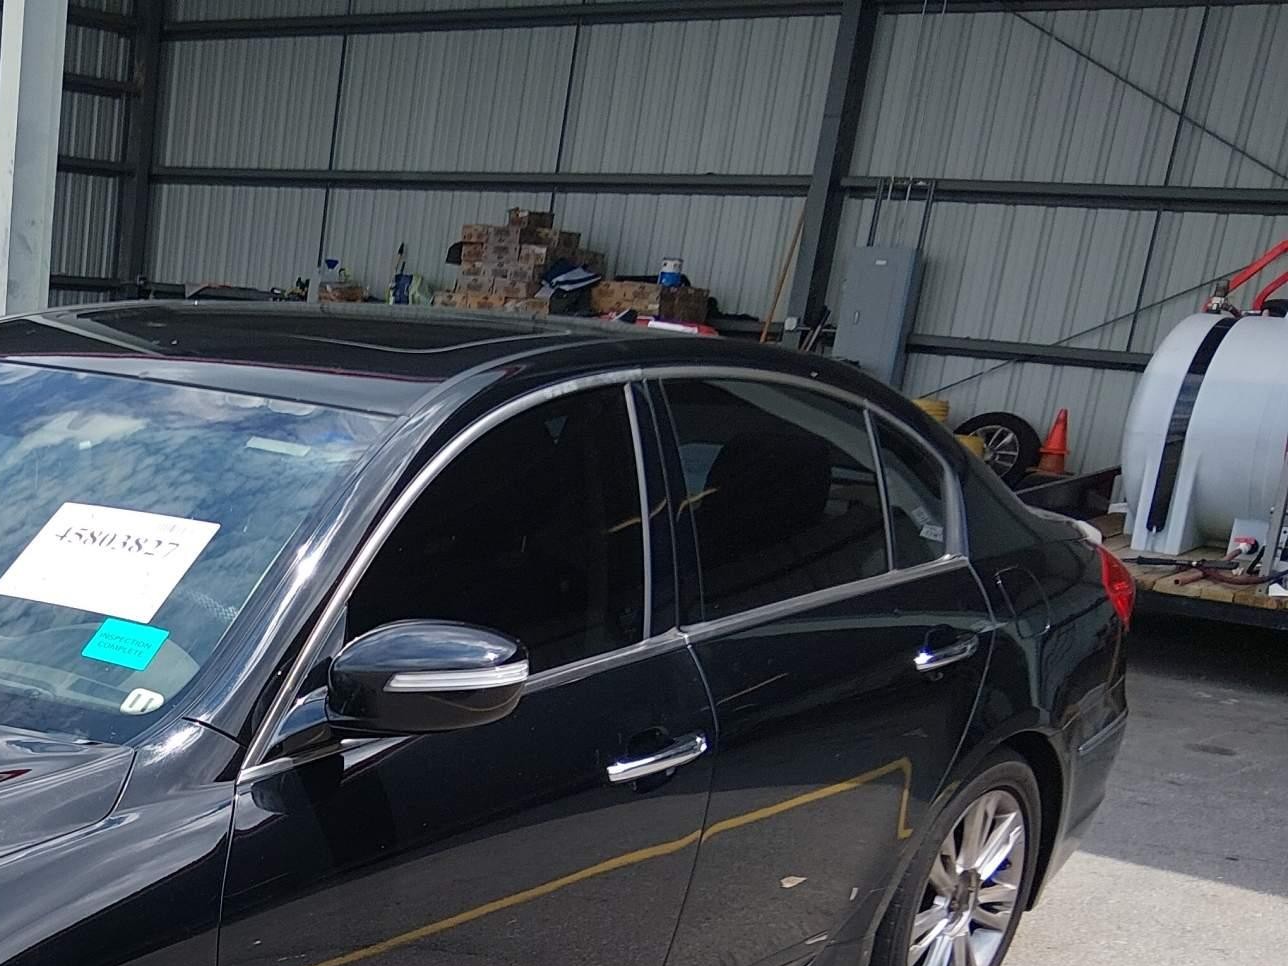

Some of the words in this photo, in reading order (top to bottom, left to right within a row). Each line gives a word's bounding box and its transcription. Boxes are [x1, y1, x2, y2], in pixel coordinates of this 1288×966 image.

[55, 527, 180, 558] 45803827
[97, 640, 145, 657] COMPLETE
[100, 631, 153, 649] INSPECTION
